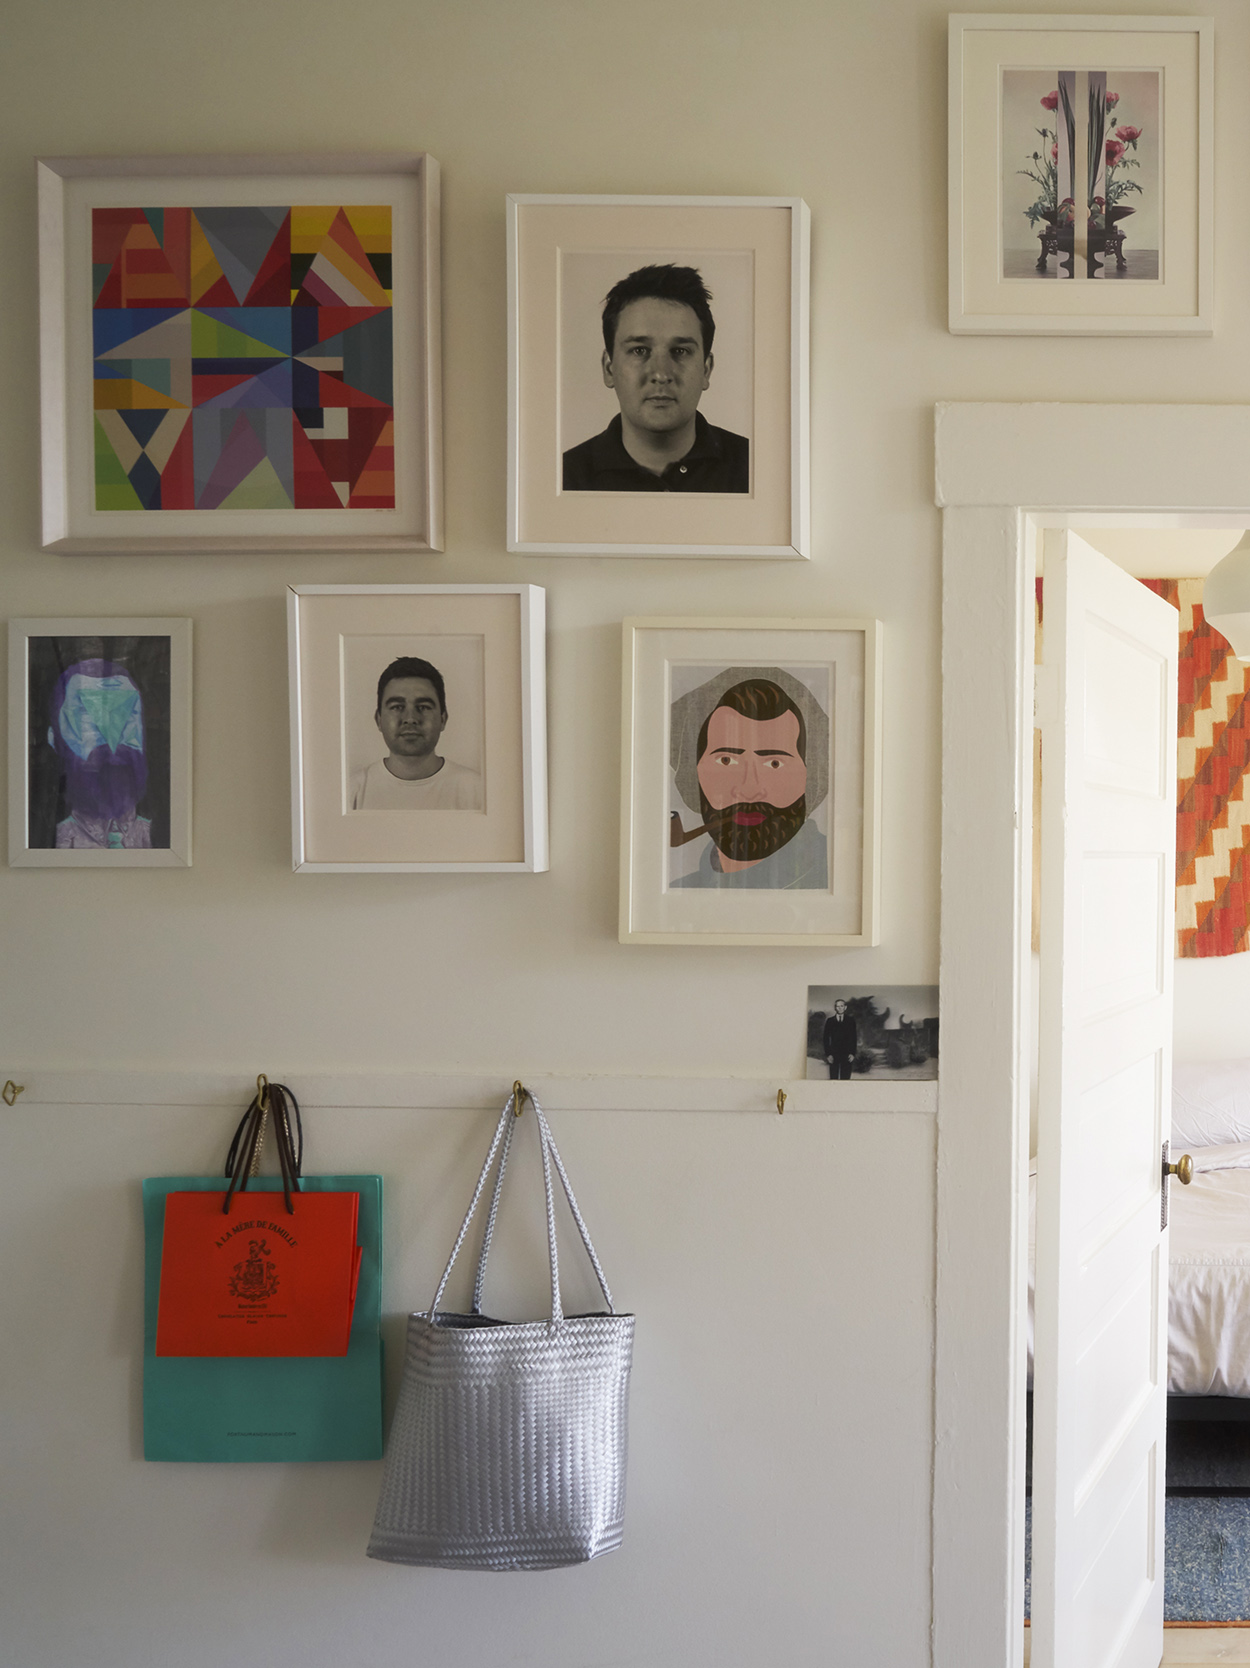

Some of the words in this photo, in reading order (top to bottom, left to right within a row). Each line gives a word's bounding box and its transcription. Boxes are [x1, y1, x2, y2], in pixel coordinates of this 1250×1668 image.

[220, 1232, 232, 1242] LA
[256, 1220, 268, 1229] DE
[268, 1222, 298, 1248] FAMILLE
